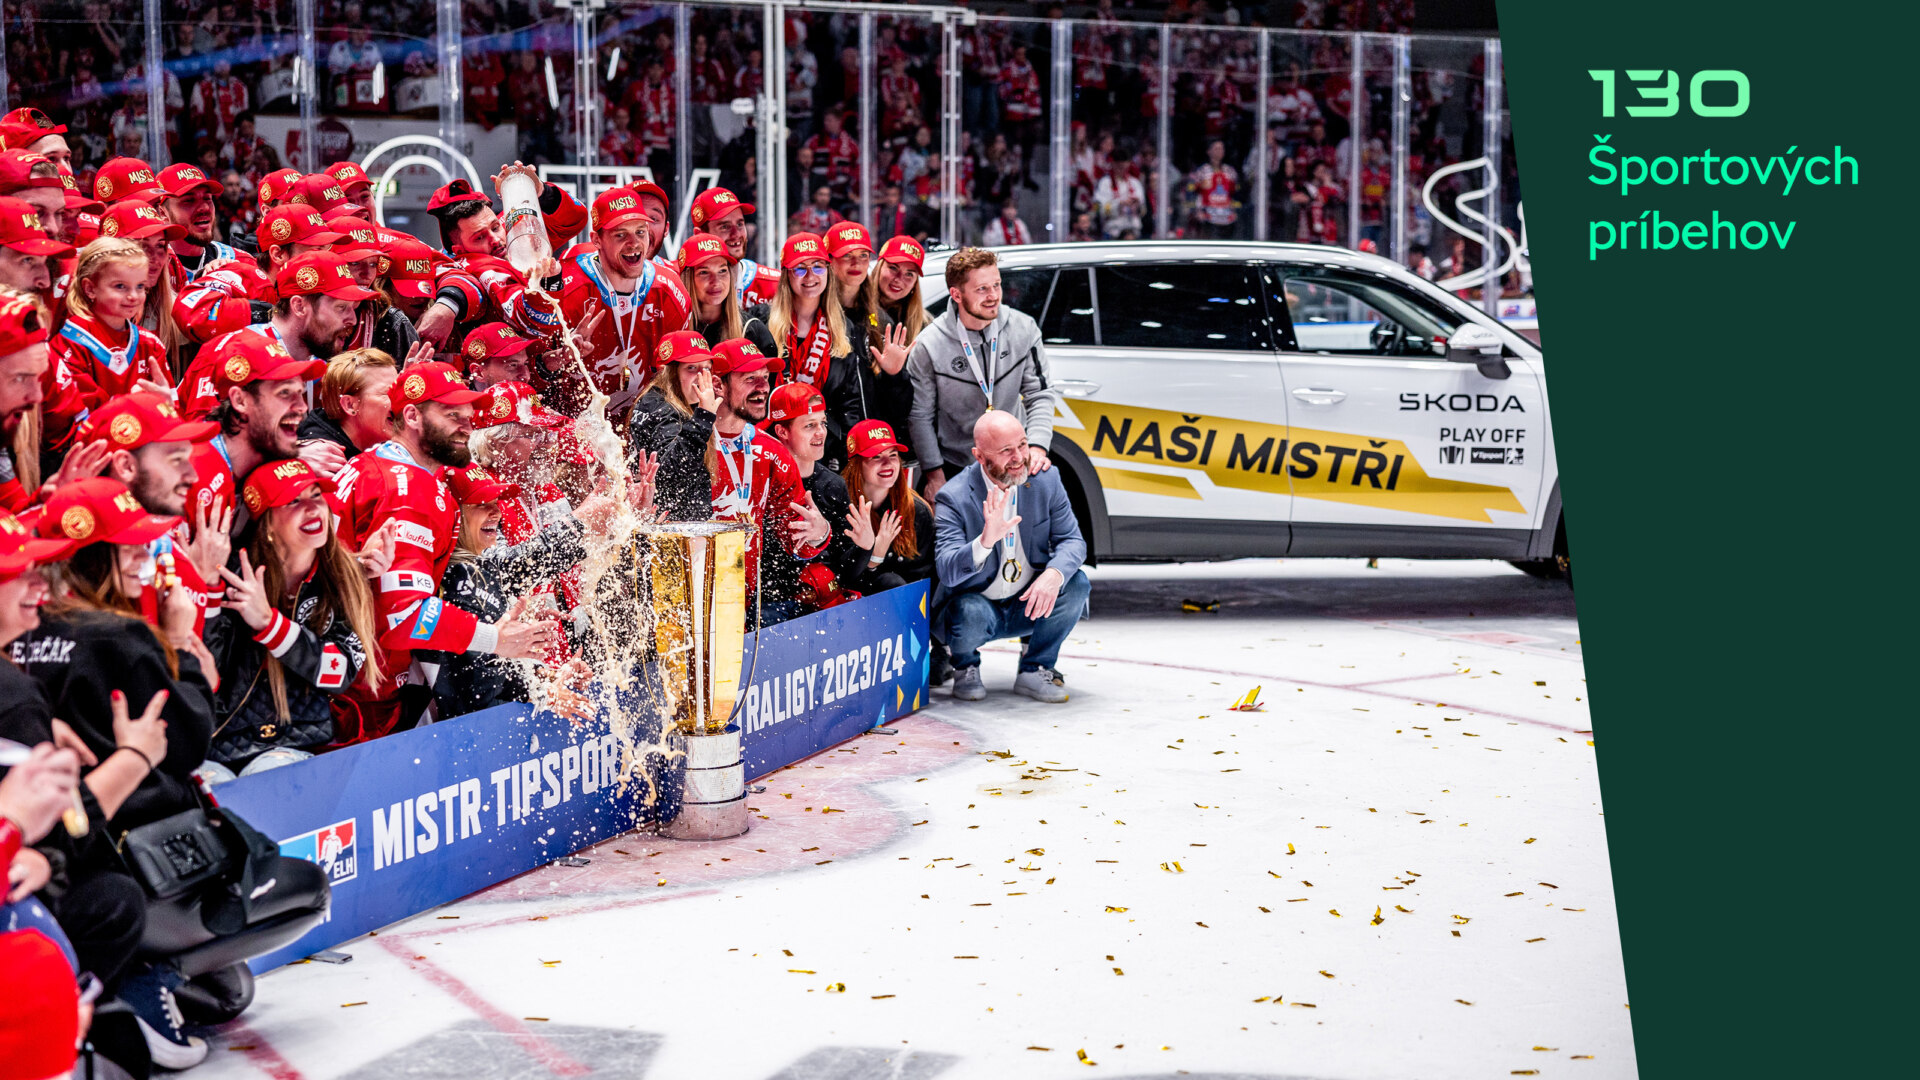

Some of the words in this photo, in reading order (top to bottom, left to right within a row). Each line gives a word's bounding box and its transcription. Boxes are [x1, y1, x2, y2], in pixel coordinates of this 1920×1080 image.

[1440, 427, 1486, 443] PLAY
[1491, 428, 1526, 443] OFF
[1092, 414, 1217, 466] NAŠI
[1226, 439, 1405, 491] MISTŘI
[416, 576, 432, 589] KB
[372, 777, 482, 871] MISTR
[490, 734, 620, 828] TIPSPOR
[735, 663, 818, 738] TRALIGY
[822, 633, 905, 705] 2023/24
[333, 856, 354, 879] ELH
